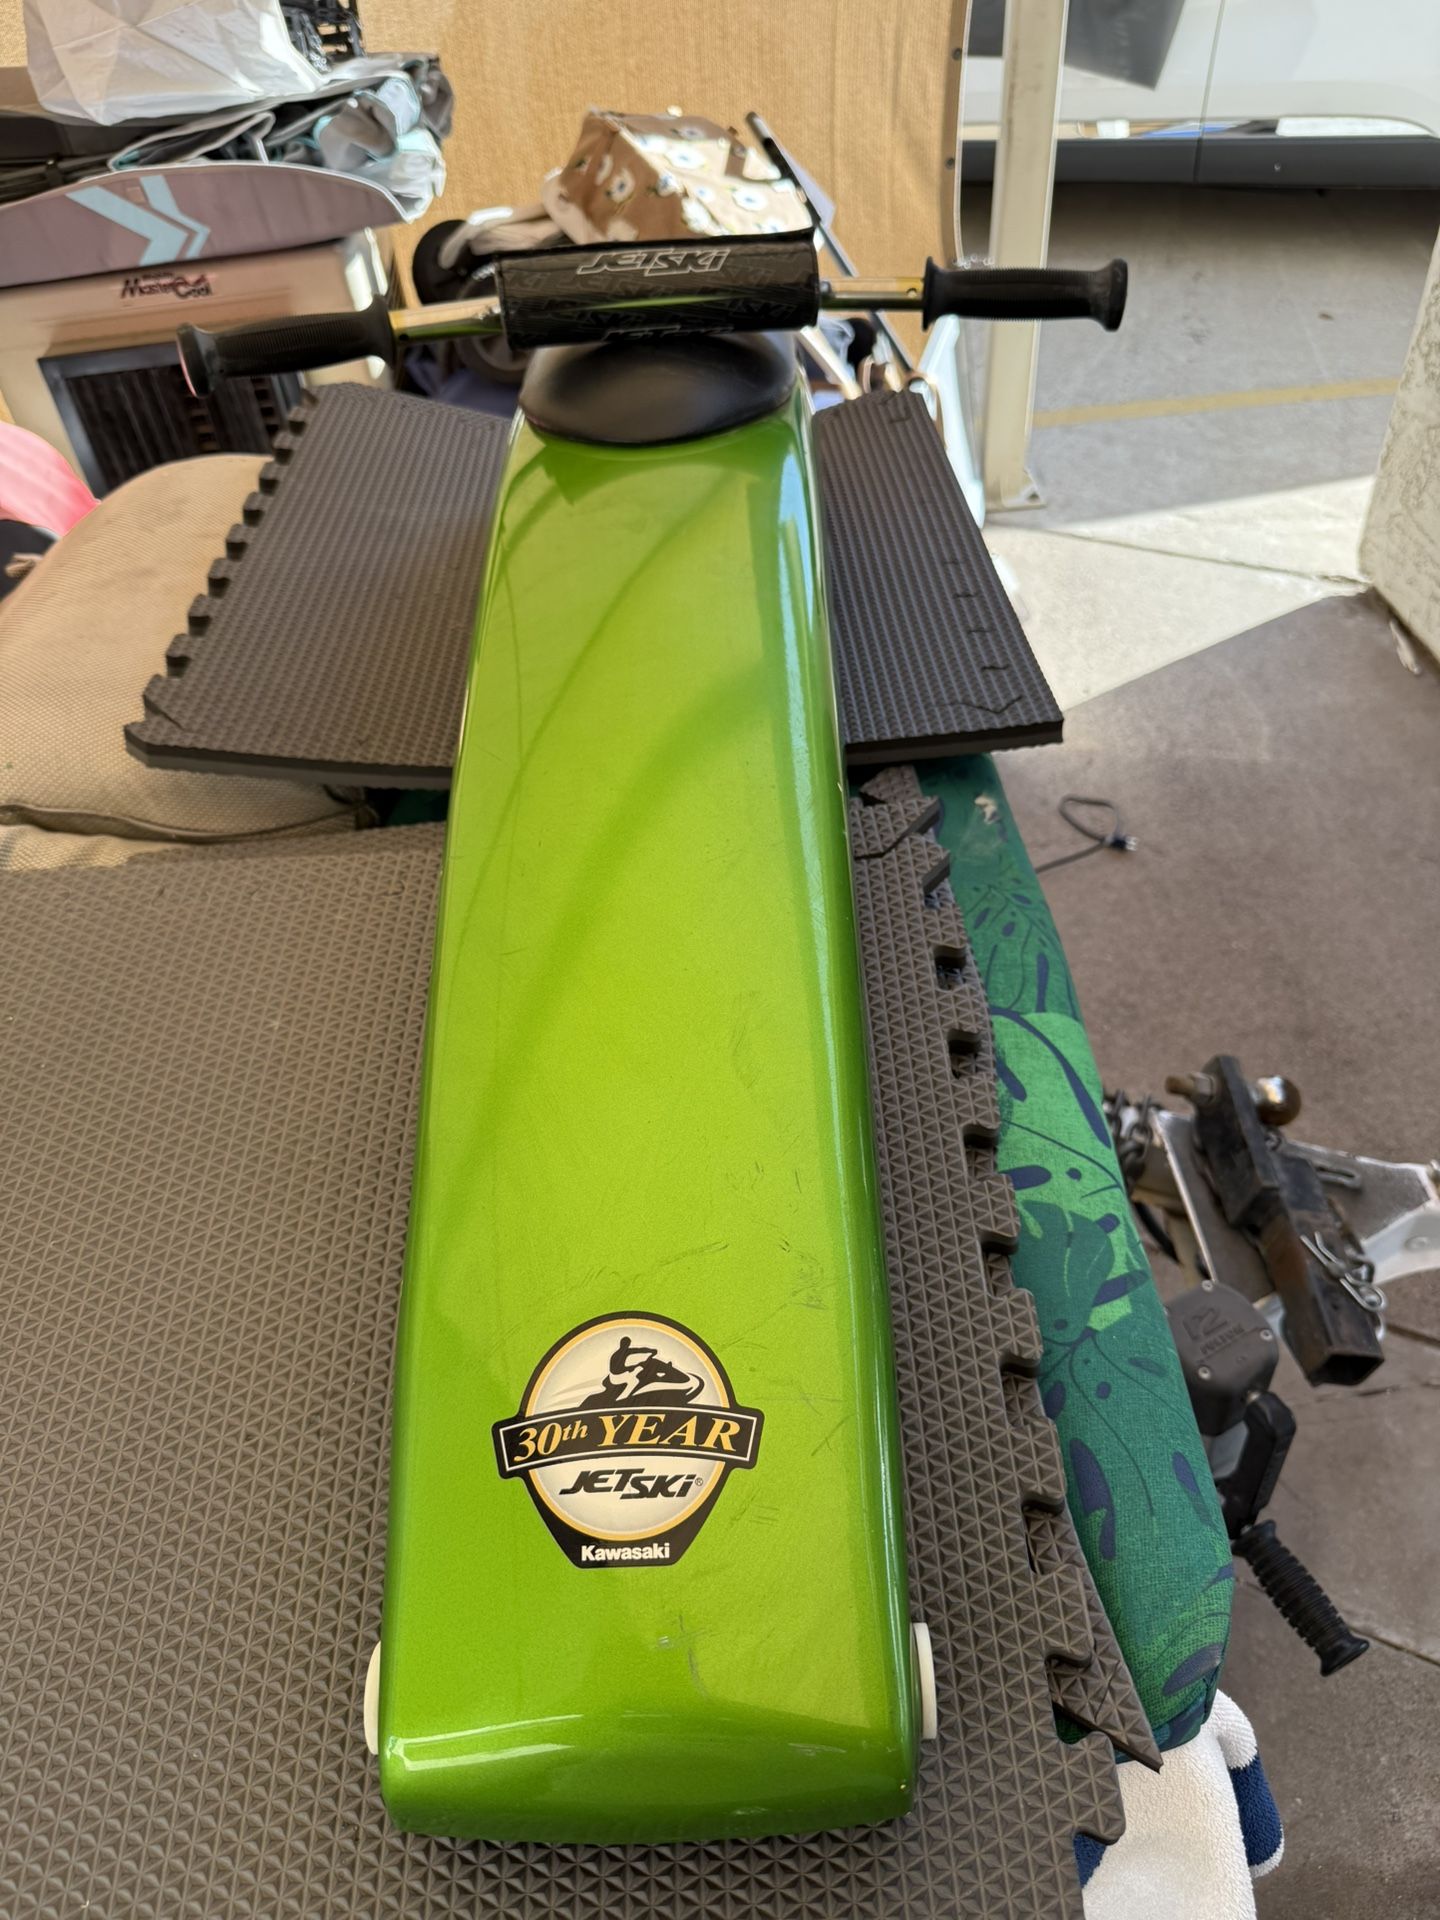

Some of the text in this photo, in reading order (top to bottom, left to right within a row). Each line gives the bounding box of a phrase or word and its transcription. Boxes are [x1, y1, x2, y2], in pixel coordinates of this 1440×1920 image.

[514, 1414, 740, 1462] 30th YEAR
[581, 1543, 670, 1562] Kawasaki
